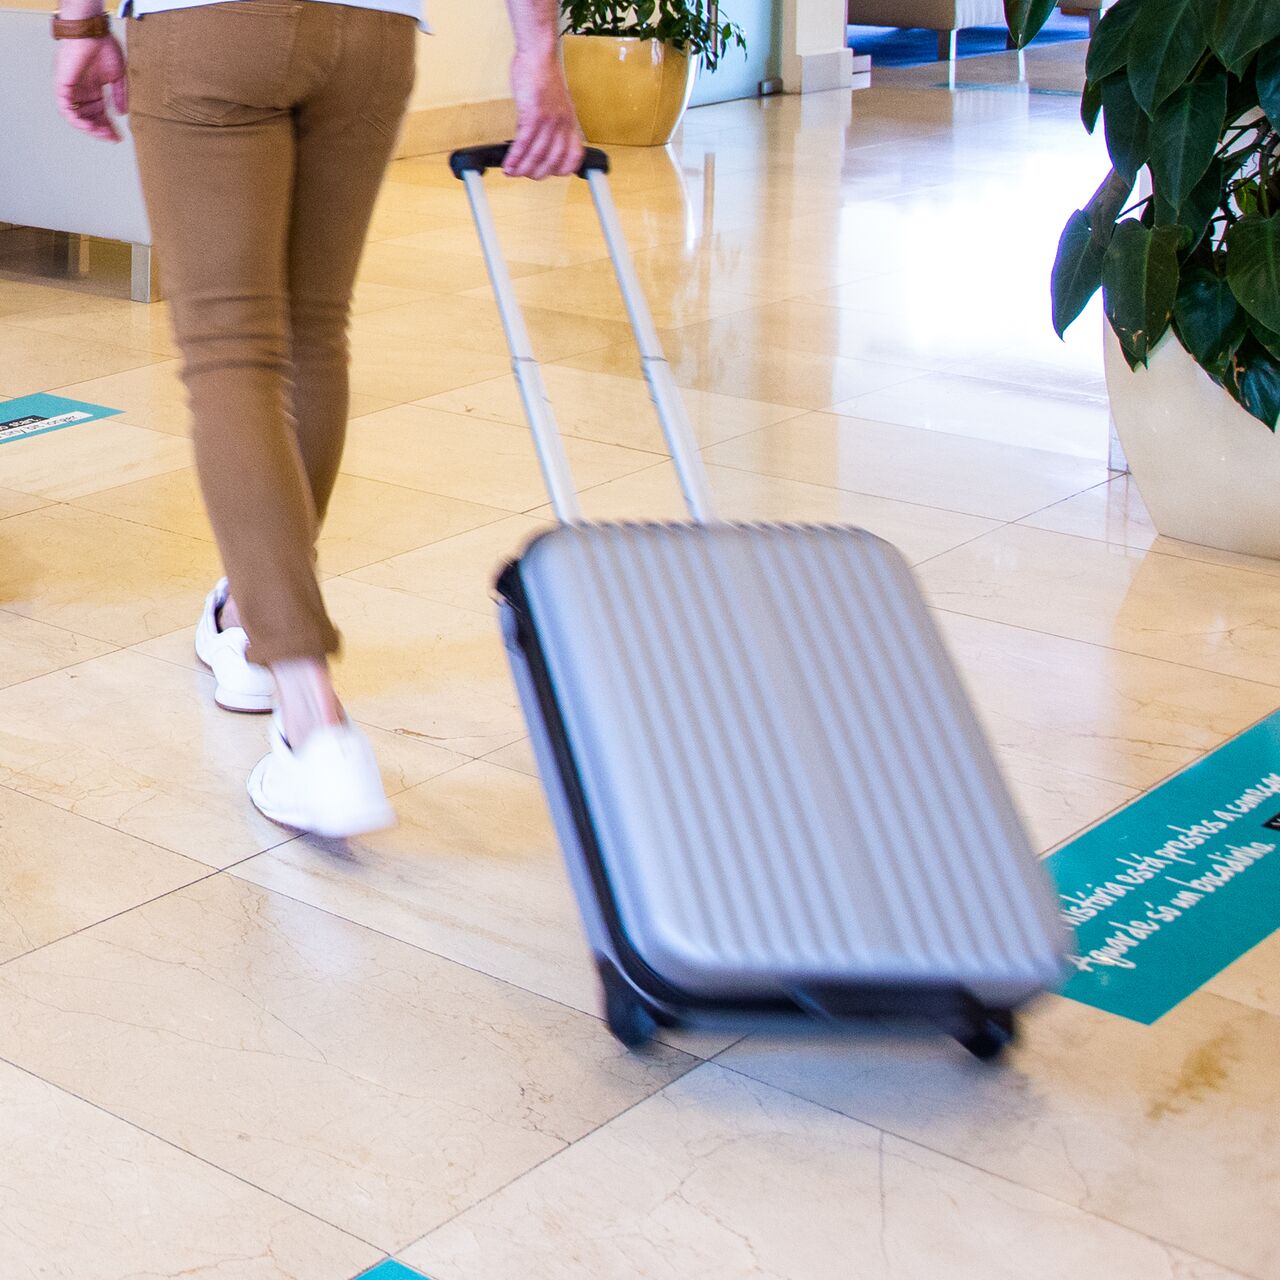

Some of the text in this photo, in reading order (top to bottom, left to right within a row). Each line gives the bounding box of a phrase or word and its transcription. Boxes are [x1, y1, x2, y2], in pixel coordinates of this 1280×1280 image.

[1115, 852, 1173, 884] está
[1154, 819, 1228, 865] prestes
[1212, 810, 1242, 822] a
[1067, 840, 1276, 972] Aguarde só um bocadinho.
